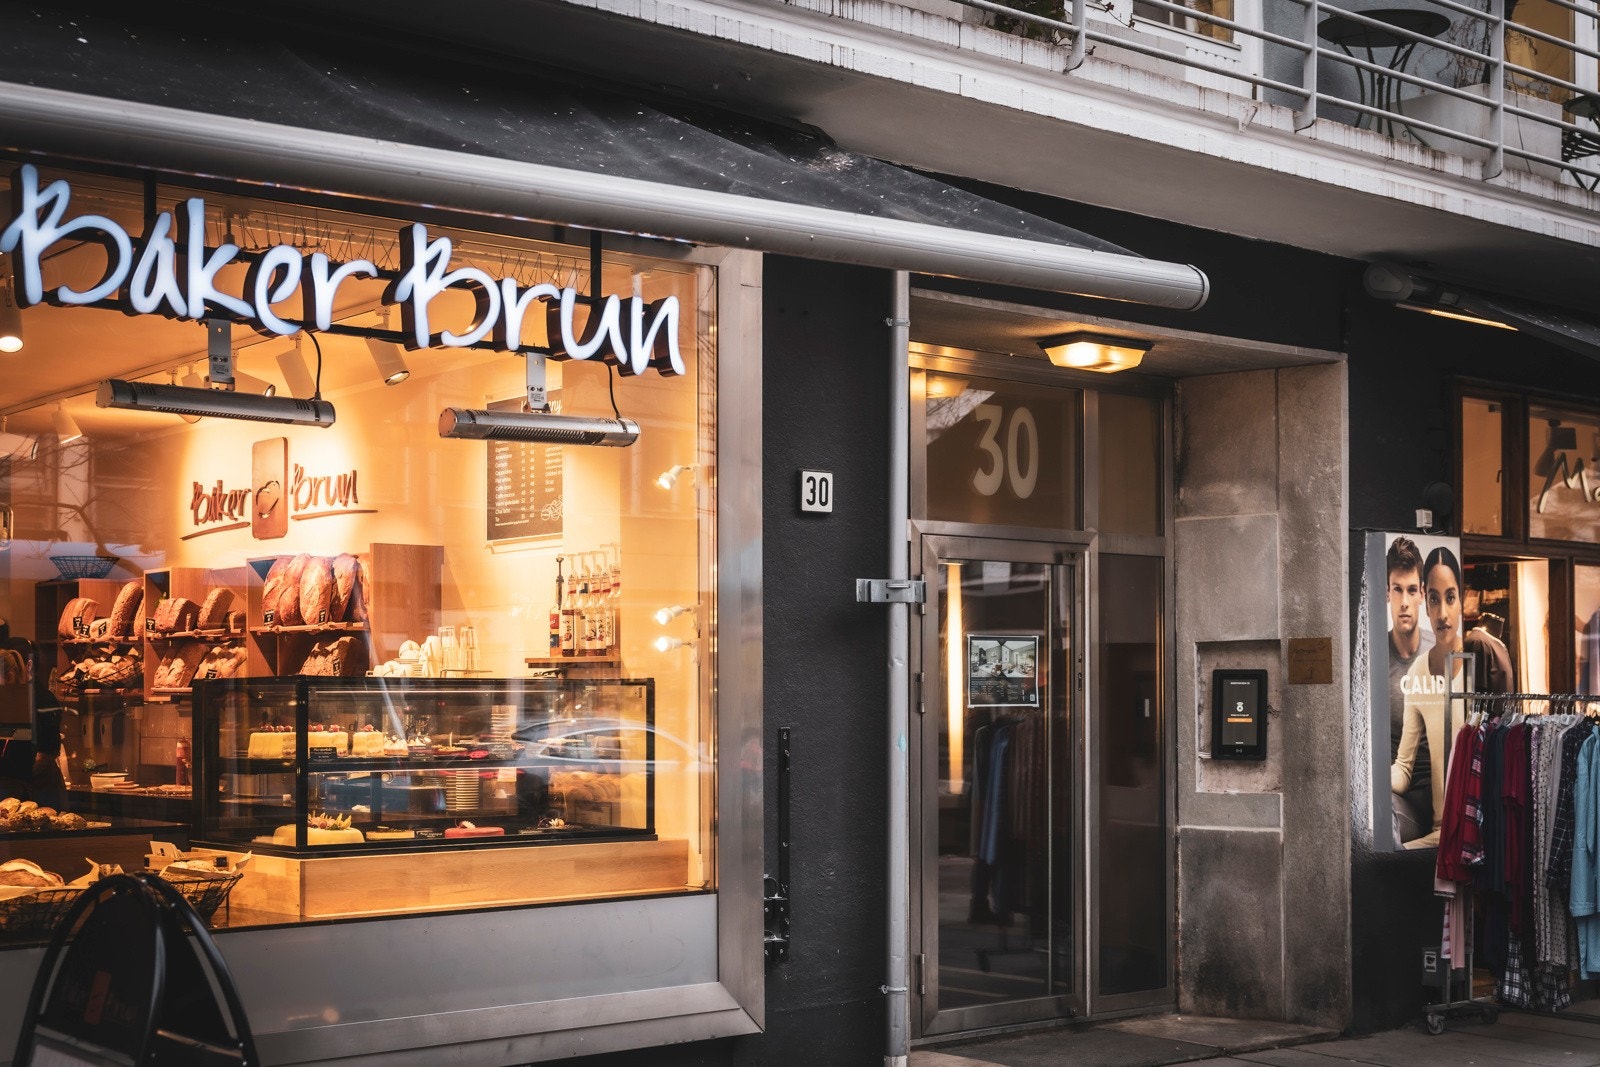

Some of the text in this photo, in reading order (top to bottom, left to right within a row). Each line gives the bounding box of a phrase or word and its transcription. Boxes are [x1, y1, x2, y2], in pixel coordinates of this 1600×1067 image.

[0, 163, 686, 377] Baker Brun
[973, 404, 1039, 499] 30
[806, 476, 829, 506] 30
[1400, 674, 1455, 695] CALID
